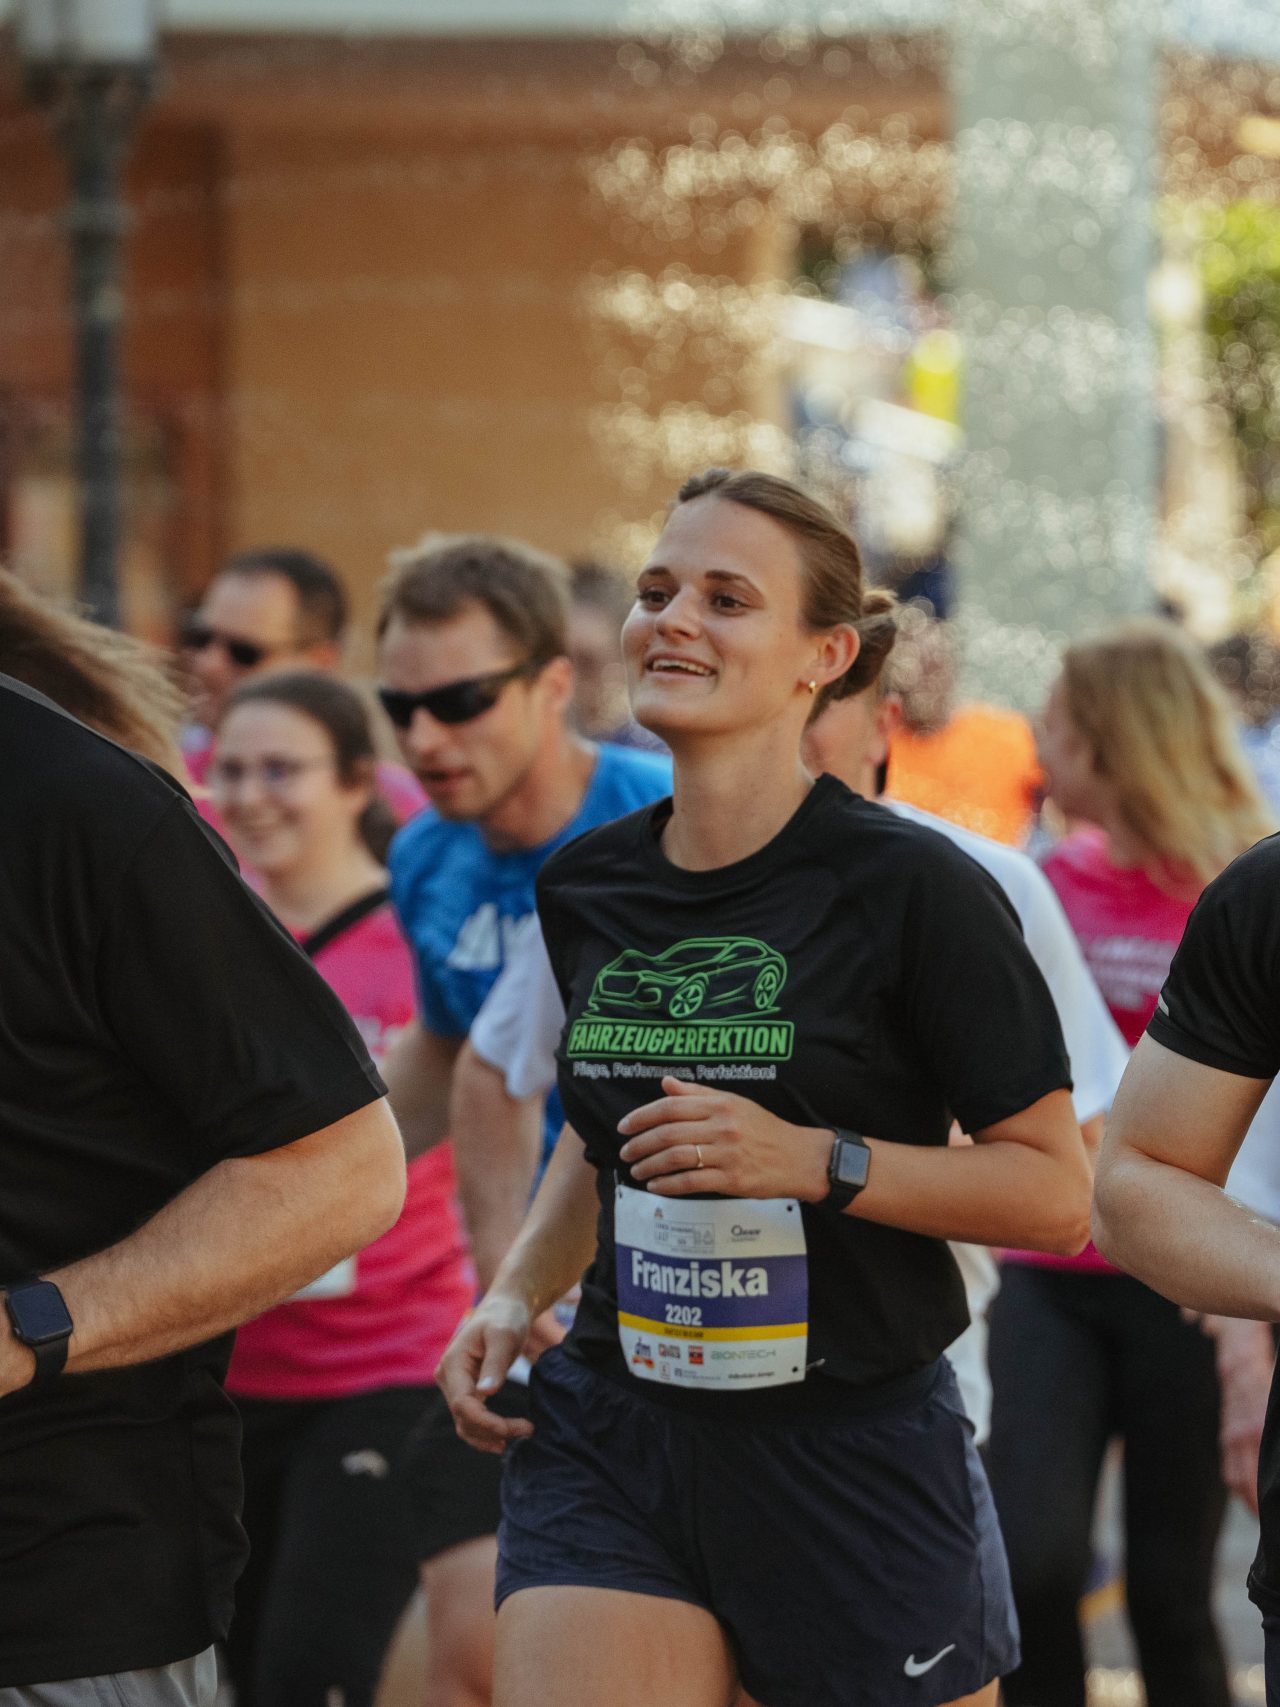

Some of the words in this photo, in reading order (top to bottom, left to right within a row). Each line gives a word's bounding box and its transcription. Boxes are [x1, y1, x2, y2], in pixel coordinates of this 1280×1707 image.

[569, 1024, 788, 1055] FAHRZEUGPERFEKTION
[697, 1065, 777, 1082] Perfektion!
[631, 1250, 769, 1298] Franziska
[665, 1304, 703, 1326] 2202
